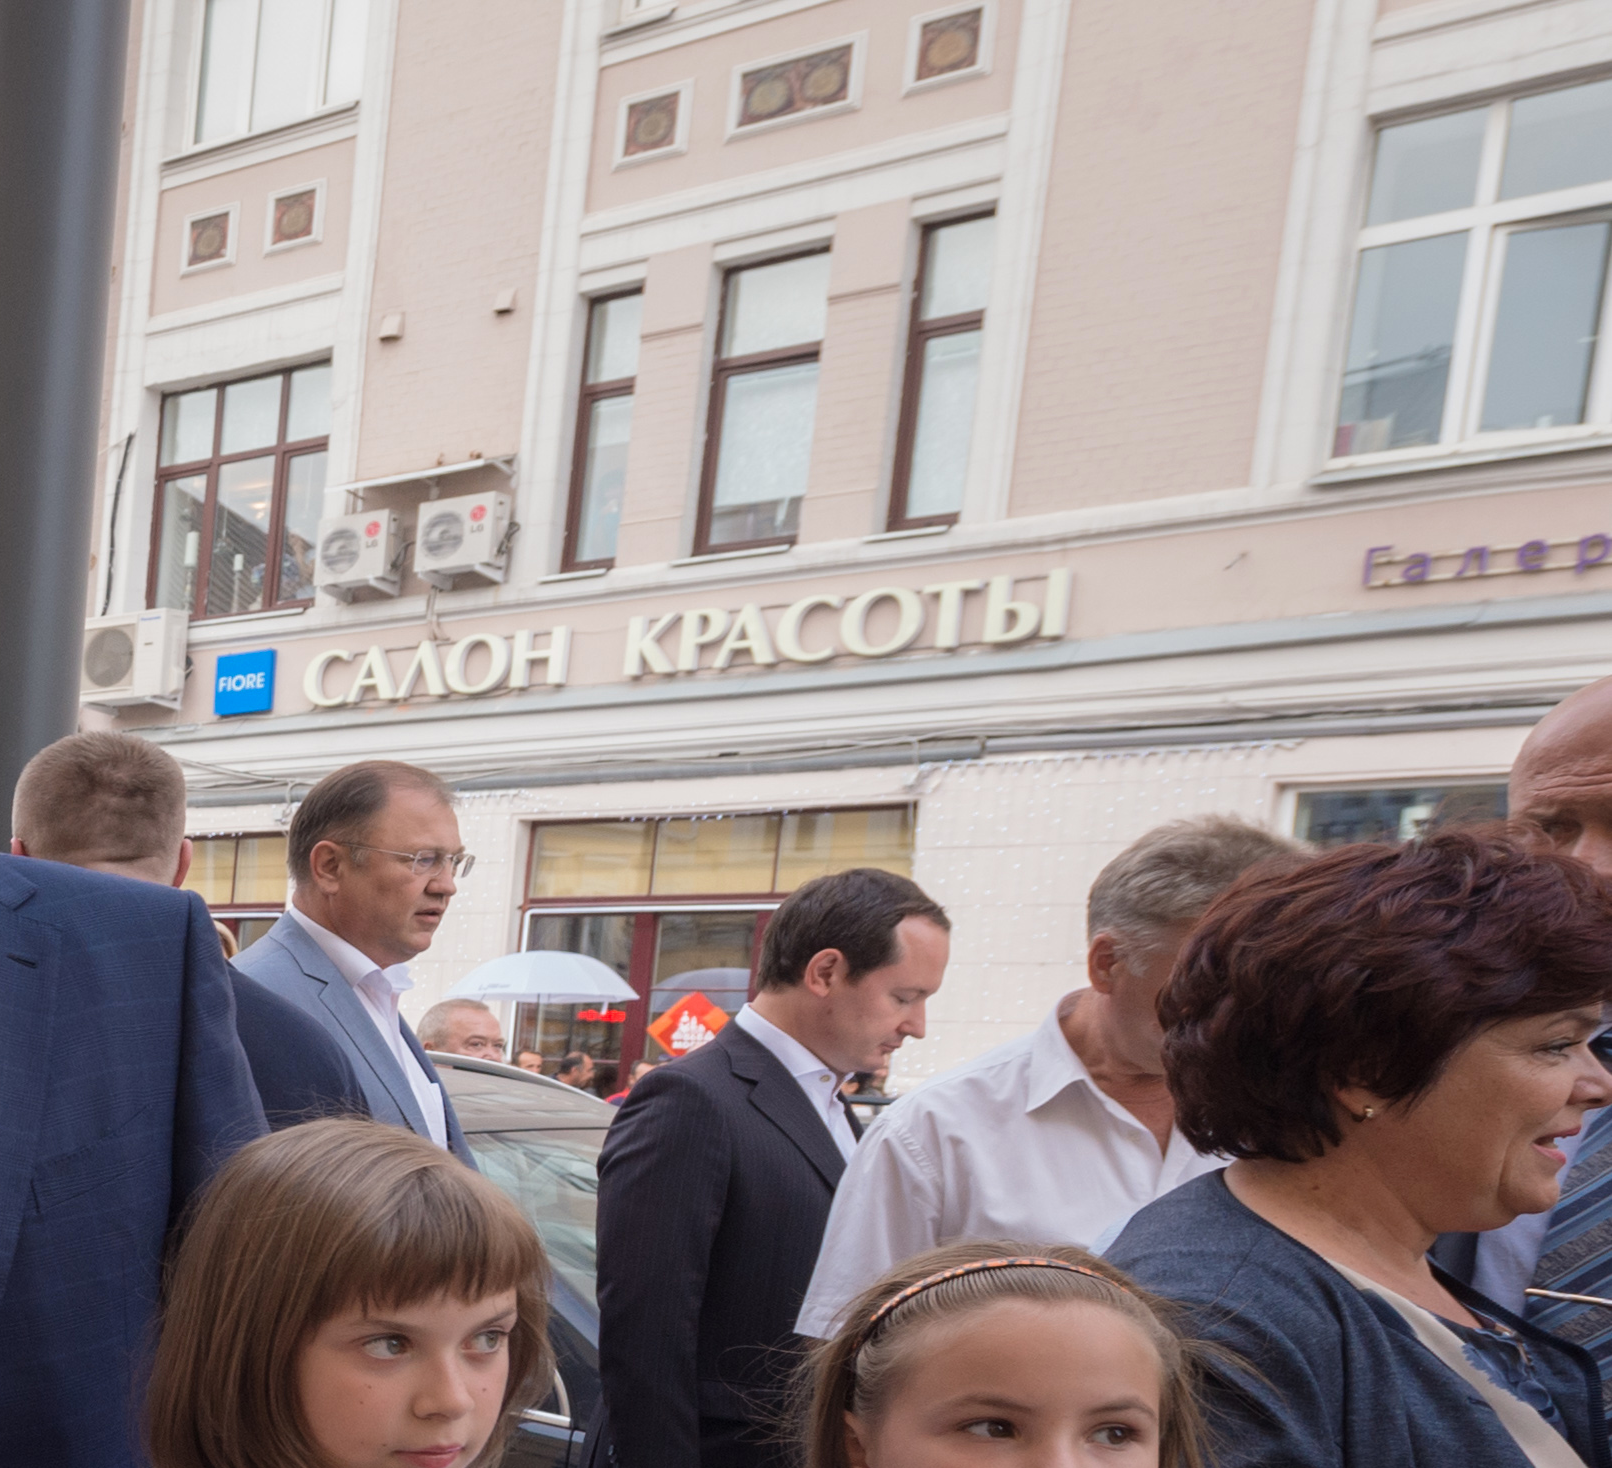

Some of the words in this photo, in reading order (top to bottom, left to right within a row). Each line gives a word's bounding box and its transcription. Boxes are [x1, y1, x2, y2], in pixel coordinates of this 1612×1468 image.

[470, 523, 484, 534] LG
[365, 538, 379, 549] LG
[1363, 533, 1611, 587] Галер
[303, 625, 572, 708] САЛОН
[623, 567, 1074, 678] КРАСОТЫ
[218, 672, 265, 693] FIORE
